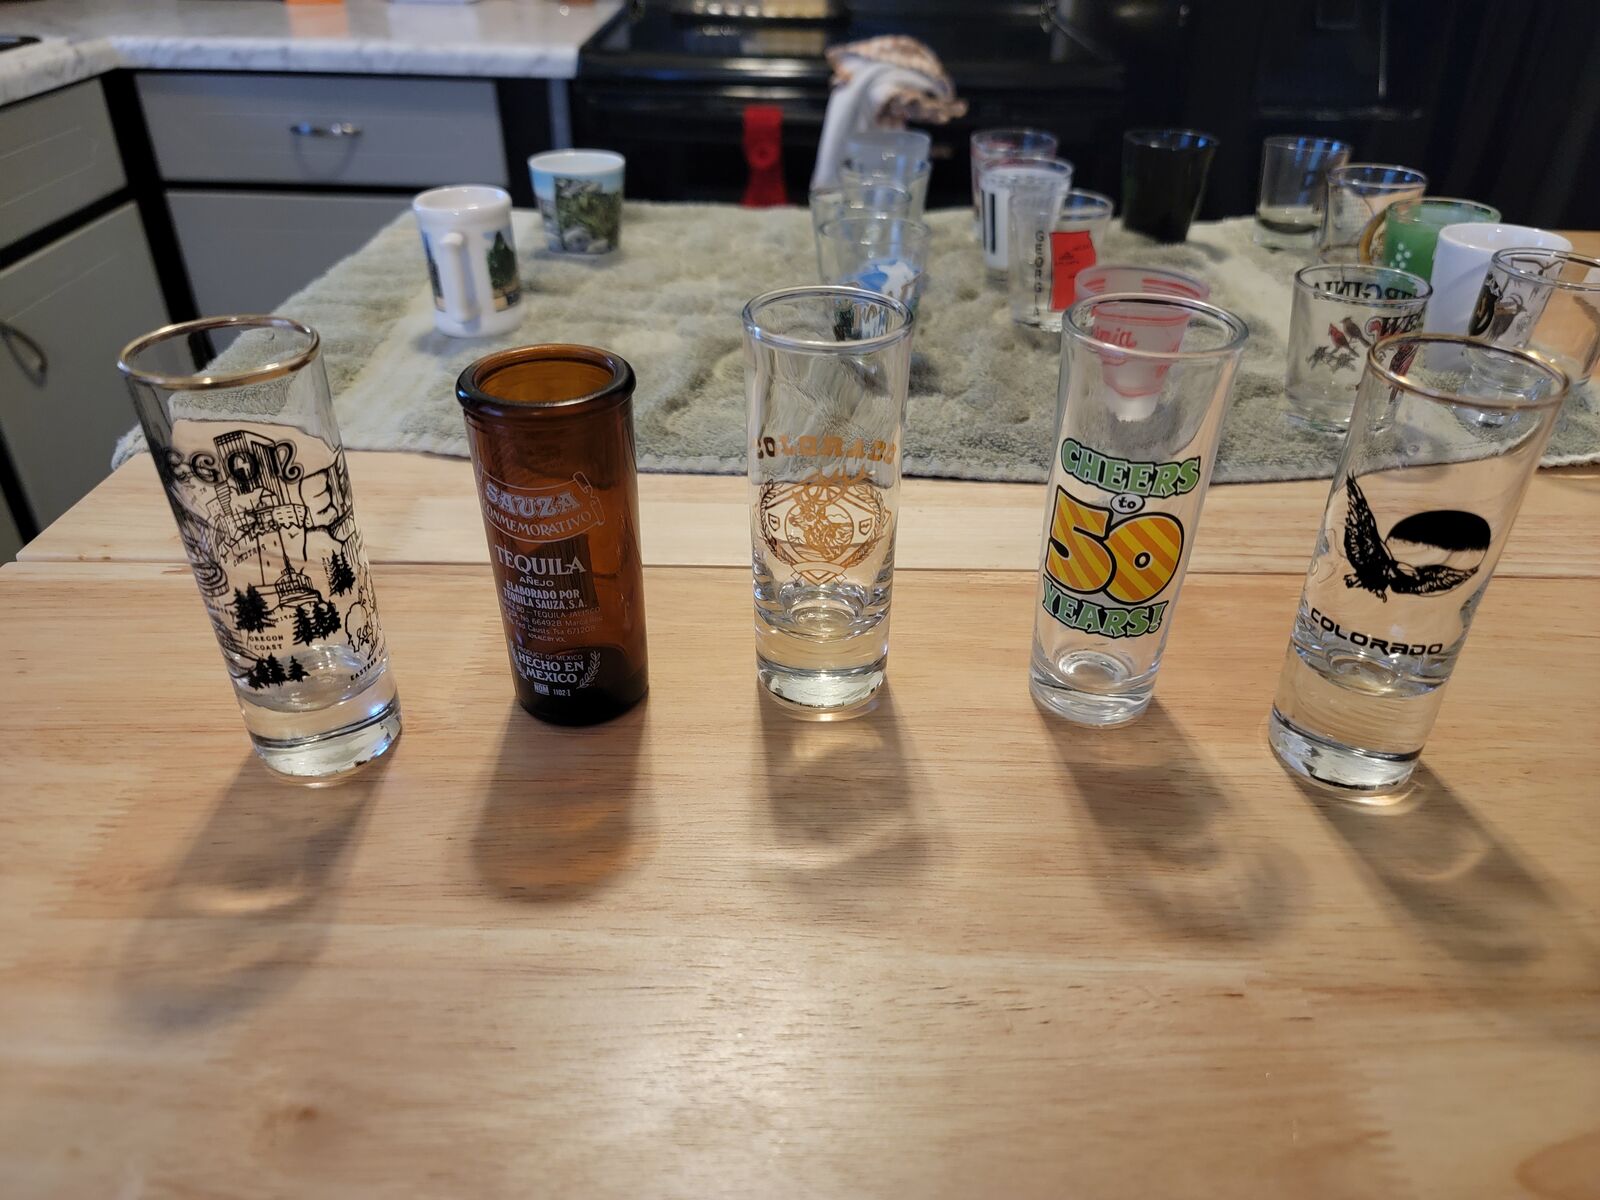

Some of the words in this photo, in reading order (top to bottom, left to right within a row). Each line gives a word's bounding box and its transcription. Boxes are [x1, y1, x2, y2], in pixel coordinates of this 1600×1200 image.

[1033, 230, 1045, 316] GEORGIA
[1060, 437, 1201, 499] CHEERS
[485, 480, 581, 519] SAUZA
[1117, 496, 1137, 510] to
[486, 504, 592, 537] ONMEMORATIVO
[1045, 484, 1185, 606] 50
[494, 545, 587, 575] TEQUILA
[506, 580, 557, 600] ELABORADO
[559, 589, 580, 599] POR
[519, 575, 555, 587] AÑEJO
[503, 586, 535, 608] TEQUILA
[1042, 573, 1169, 639] YEARS!
[533, 609, 566, 619] TEQUILA
[248, 634, 284, 643] OREGON
[1310, 607, 1443, 657] COLORADO
[253, 642, 284, 652] COAST
[518, 651, 561, 672] HECHO
[564, 660, 584, 672] EN
[526, 666, 578, 684] MEXICO
